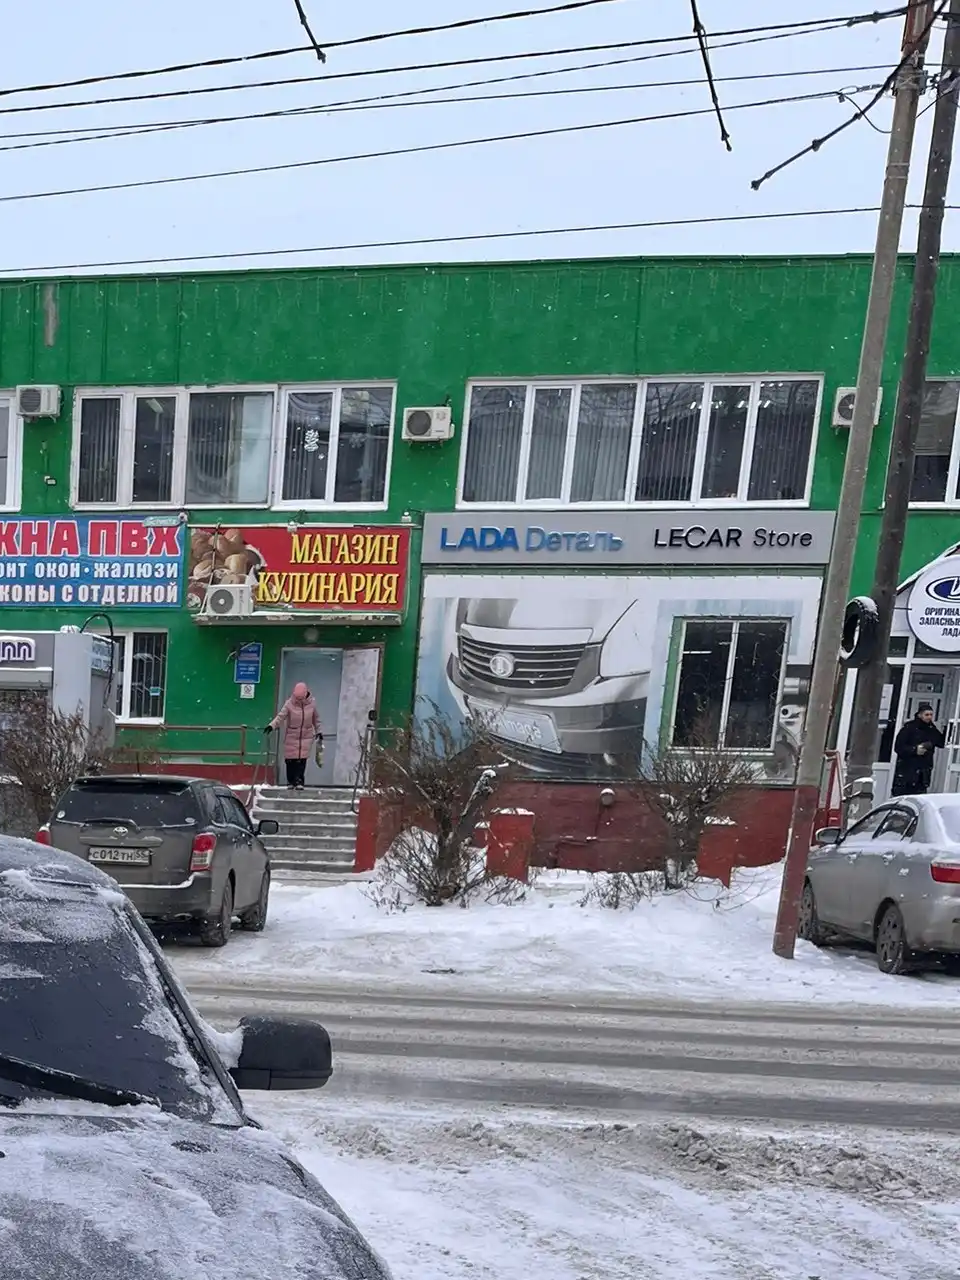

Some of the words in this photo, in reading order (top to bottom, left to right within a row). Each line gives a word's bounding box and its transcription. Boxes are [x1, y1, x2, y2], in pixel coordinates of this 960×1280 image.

[88, 520, 180, 557] ПВХ
[440, 527, 519, 552] LADA
[654, 525, 742, 549] LECAR
[753, 528, 813, 548] Store
[290, 534, 400, 565] МАГАЗИН
[34, 562, 80, 577] ОКОН
[61, 585, 73, 602] С
[78, 582, 178, 605] ОТДЕЛКОЙ
[255, 572, 399, 604] КУЛИНАРИЯ
[924, 607, 960, 616] ОРИГИНА
[941, 628, 960, 637] ЛАД
